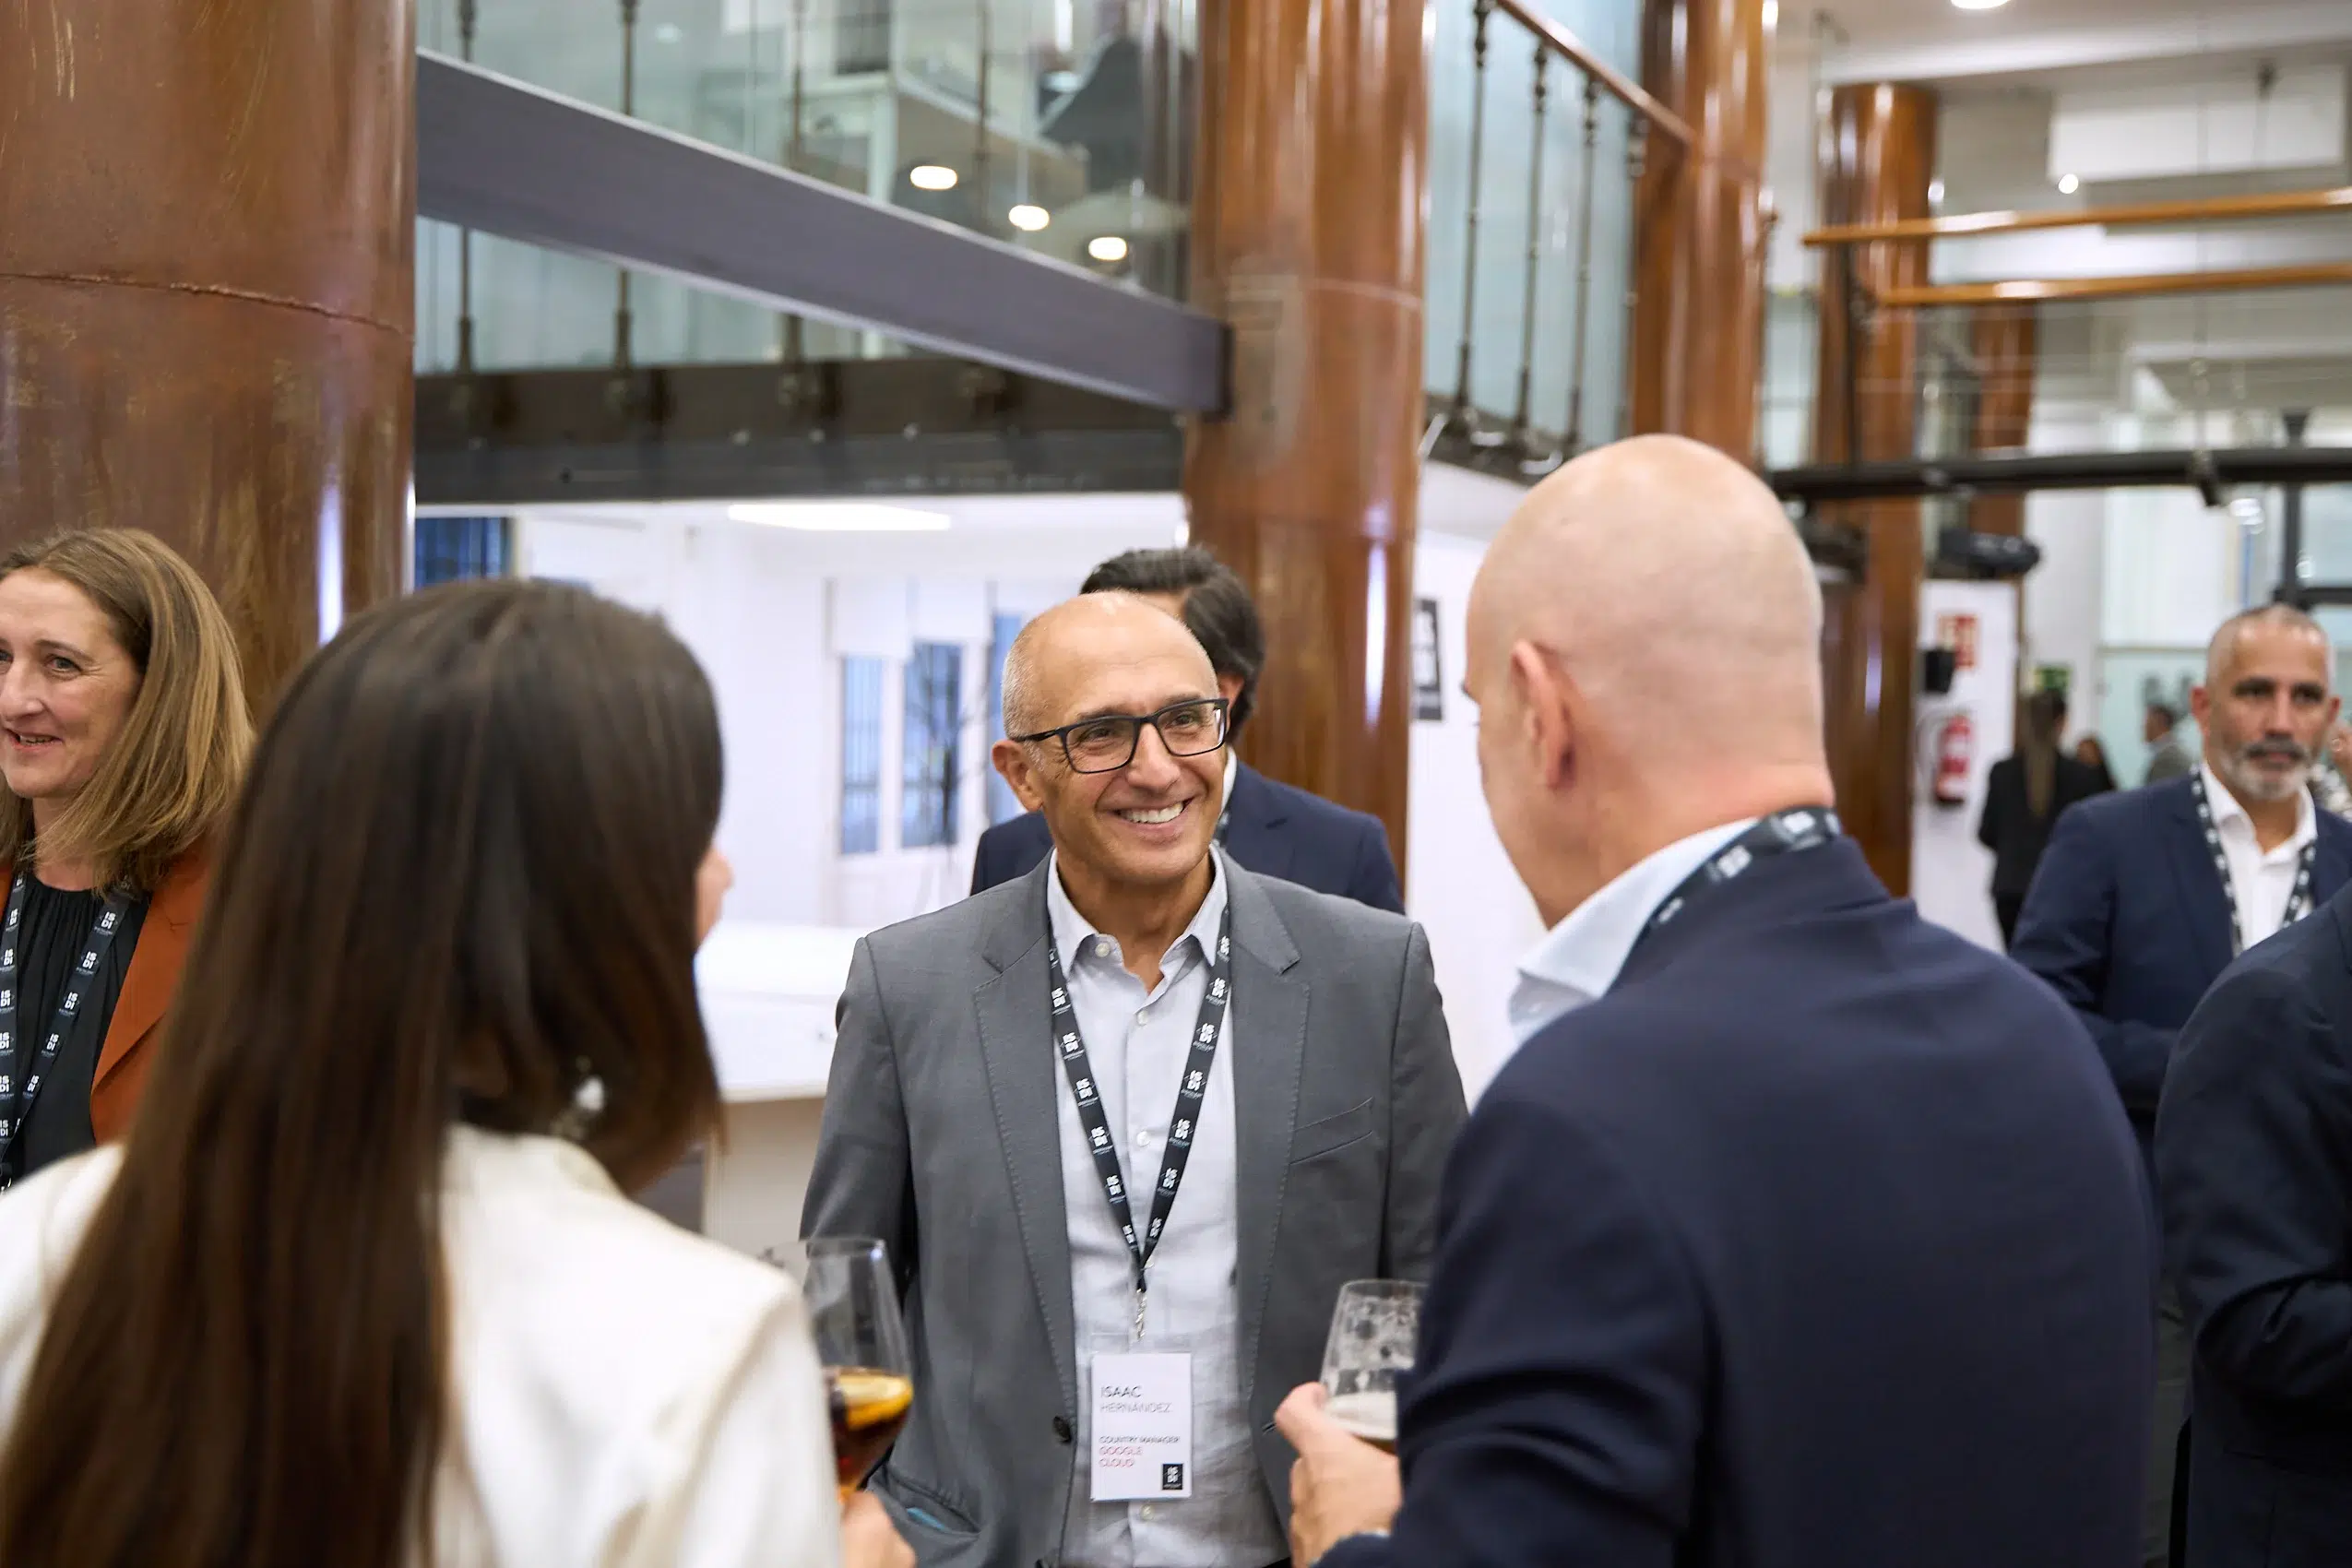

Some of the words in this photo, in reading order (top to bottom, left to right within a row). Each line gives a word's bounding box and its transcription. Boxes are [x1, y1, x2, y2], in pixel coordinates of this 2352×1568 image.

[105, 911, 116, 921] IS
[101, 920, 113, 929] DI
[5, 948, 14, 958] IS
[86, 951, 97, 961] IS
[3, 956, 13, 966] DI
[82, 959, 94, 968] DI
[0, 990, 11, 999] IS
[68, 992, 78, 1001] IS
[0, 997, 10, 1006] DI
[65, 1000, 76, 1010] DI
[50, 1033, 59, 1042] IS
[46, 1041, 56, 1051] DI
[1100, 1386, 1142, 1397] ISAAC
[1099, 1435, 1137, 1443] COUNTRY
[1099, 1446, 1142, 1455] GOOGLE
[1099, 1457, 1134, 1467] CLOUD
